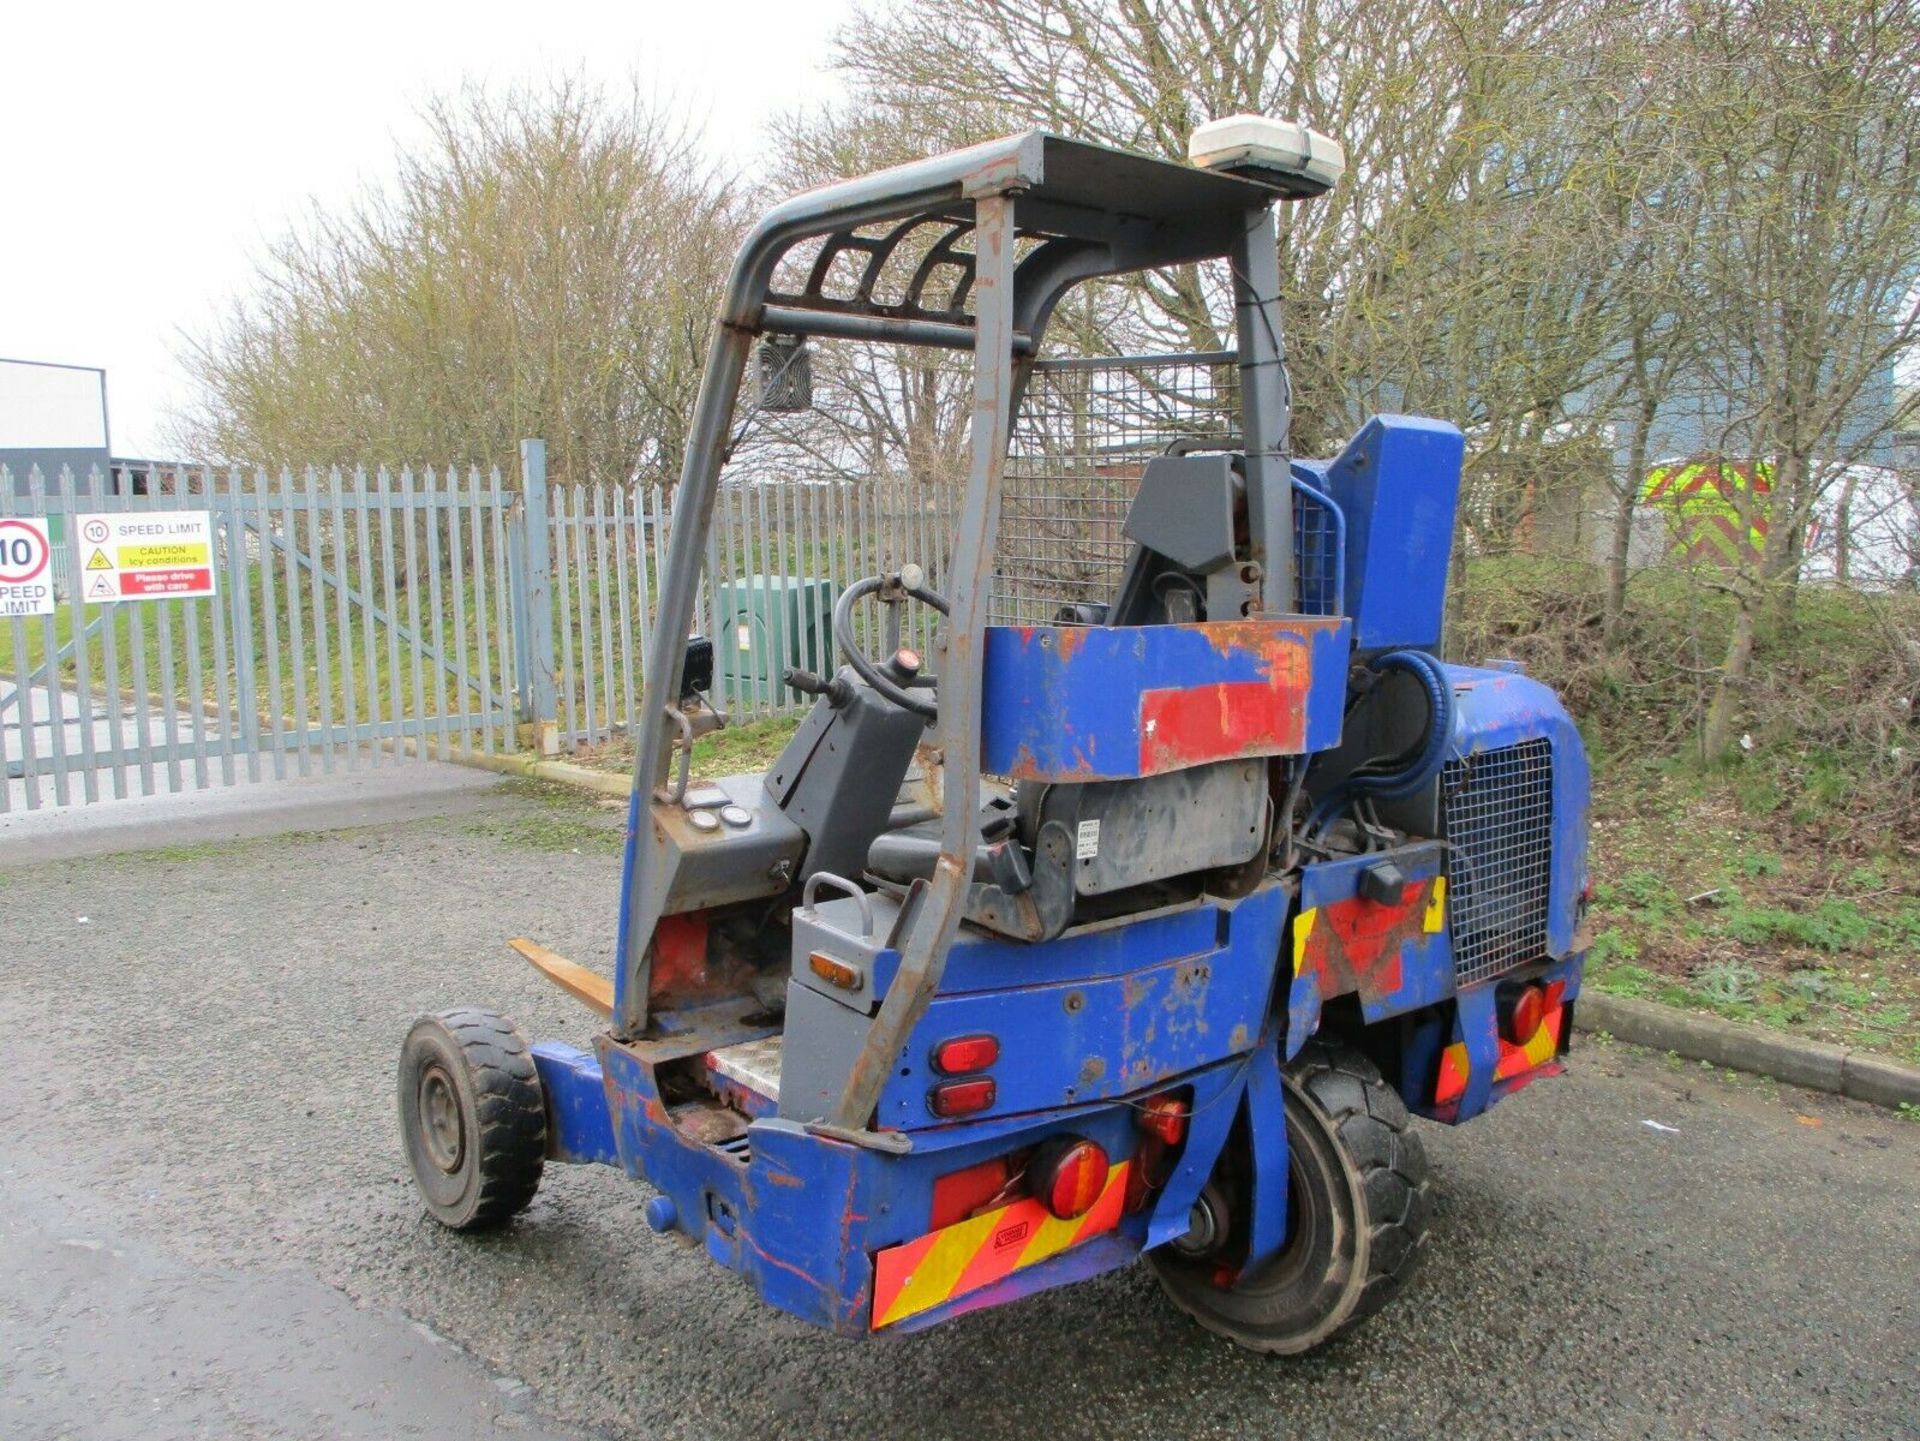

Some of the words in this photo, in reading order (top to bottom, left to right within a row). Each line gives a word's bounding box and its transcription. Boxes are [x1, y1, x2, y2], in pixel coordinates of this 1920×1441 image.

[89, 526, 104, 537] 10
[119, 524, 164, 536] SPEED
[169, 523, 201, 534] LIMIT
[0, 539, 32, 566] 10
[140, 546, 186, 555] CAUTION
[129, 557, 144, 567] Icy
[146, 556, 198, 565] conditions
[135, 573, 169, 583] Please
[170, 571, 195, 580] drive
[0, 585, 46, 599] PEED
[143, 582, 165, 592] with
[167, 583, 189, 591] care
